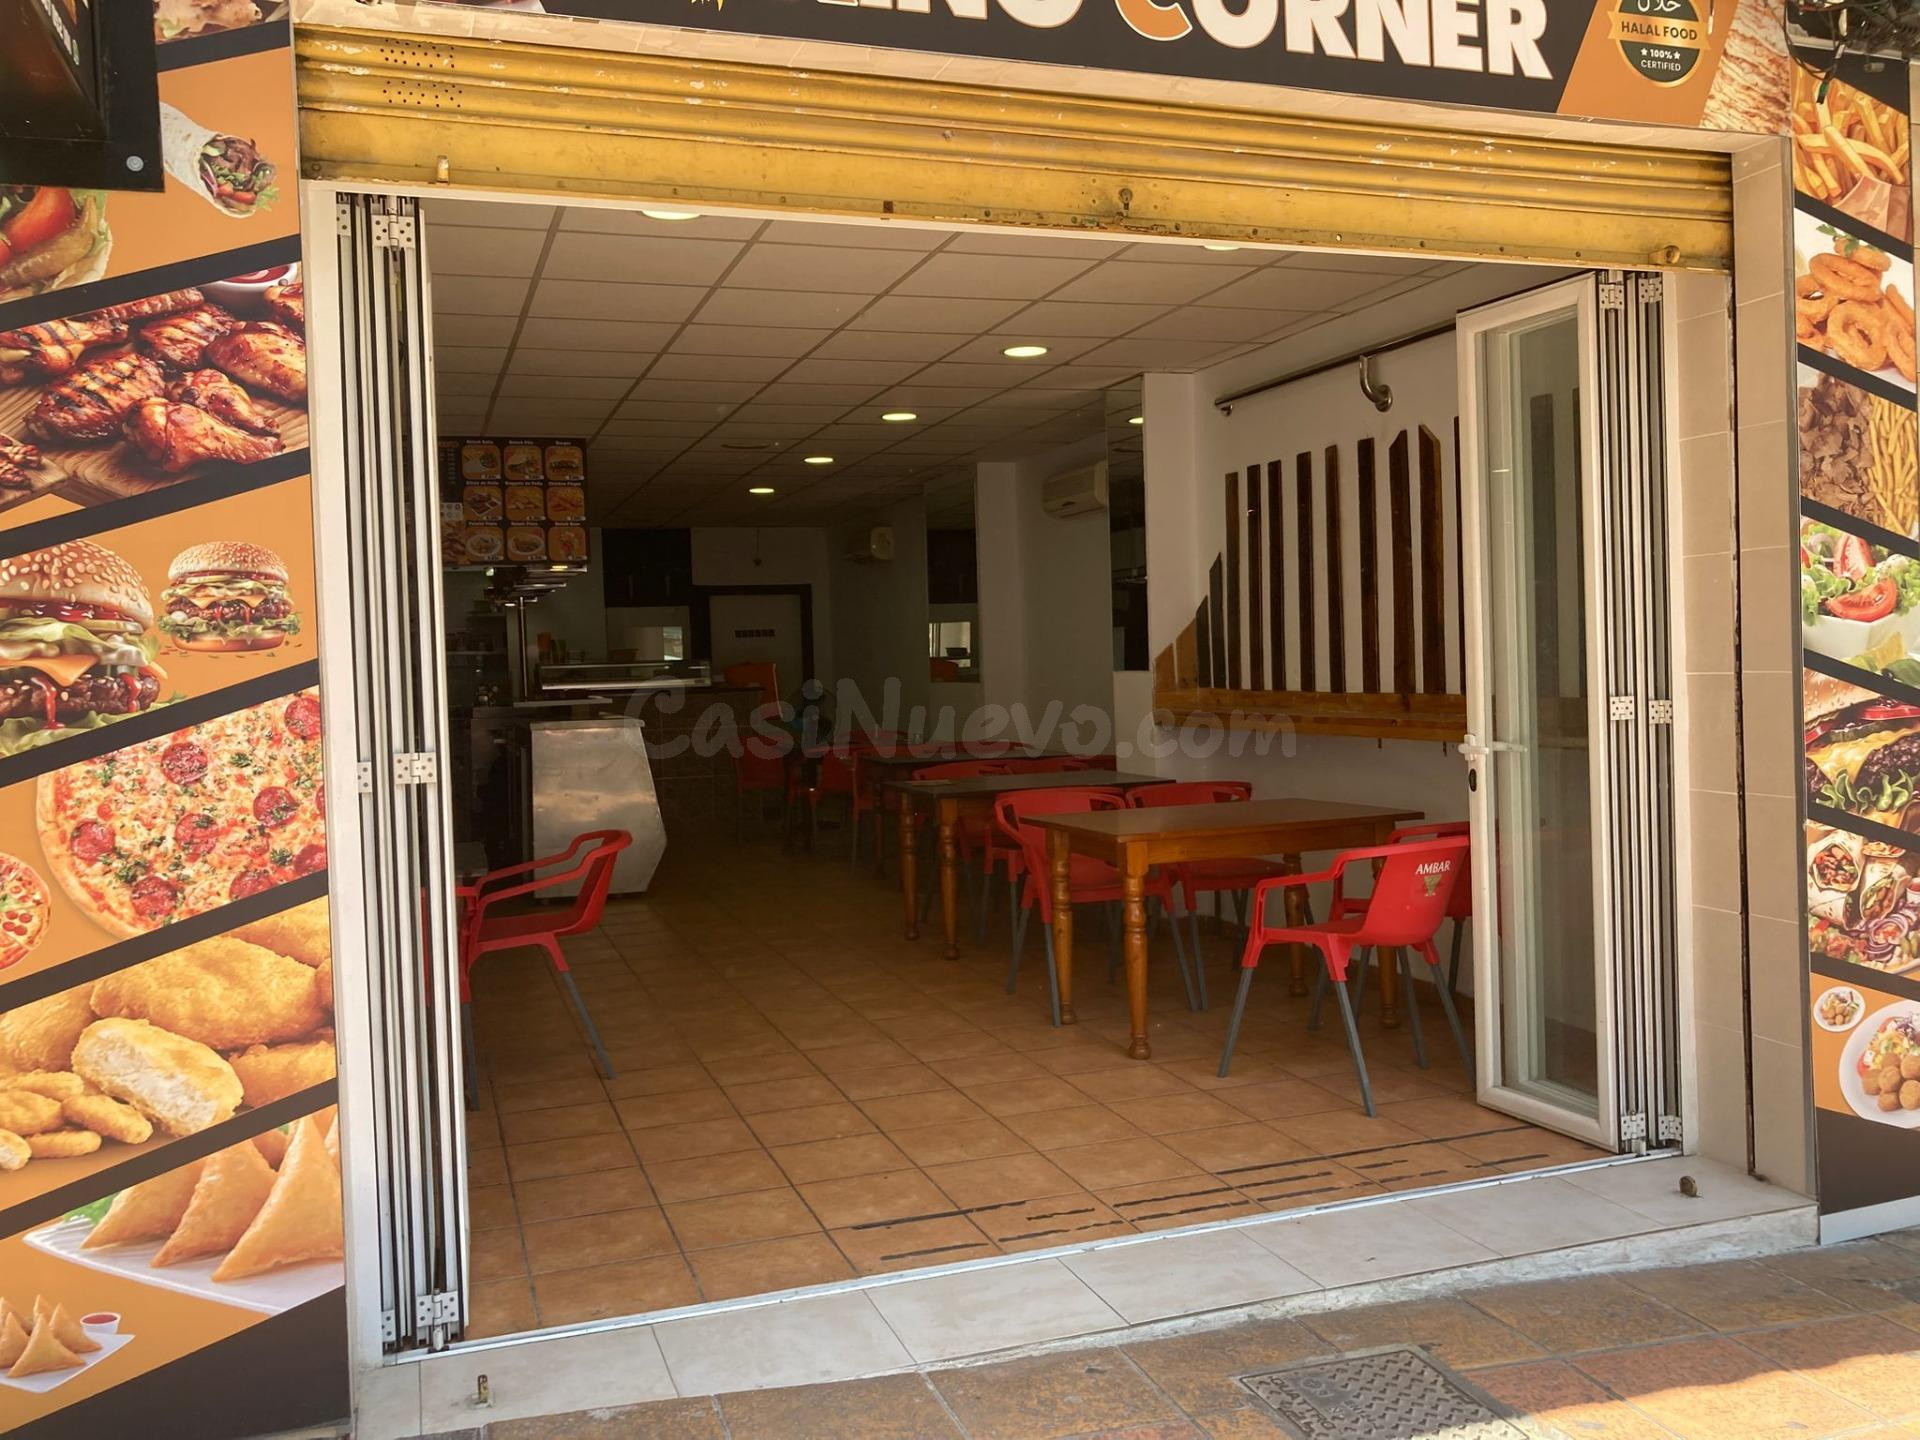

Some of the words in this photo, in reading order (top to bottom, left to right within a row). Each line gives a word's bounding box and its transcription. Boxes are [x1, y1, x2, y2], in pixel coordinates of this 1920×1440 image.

[1621, 21, 1660, 37] HALAL
[1663, 26, 1698, 41] FOOD
[1650, 48, 1673, 60] 100%
[1640, 59, 1682, 72] CERTIFIED
[1415, 860, 1451, 875] AMBAR
